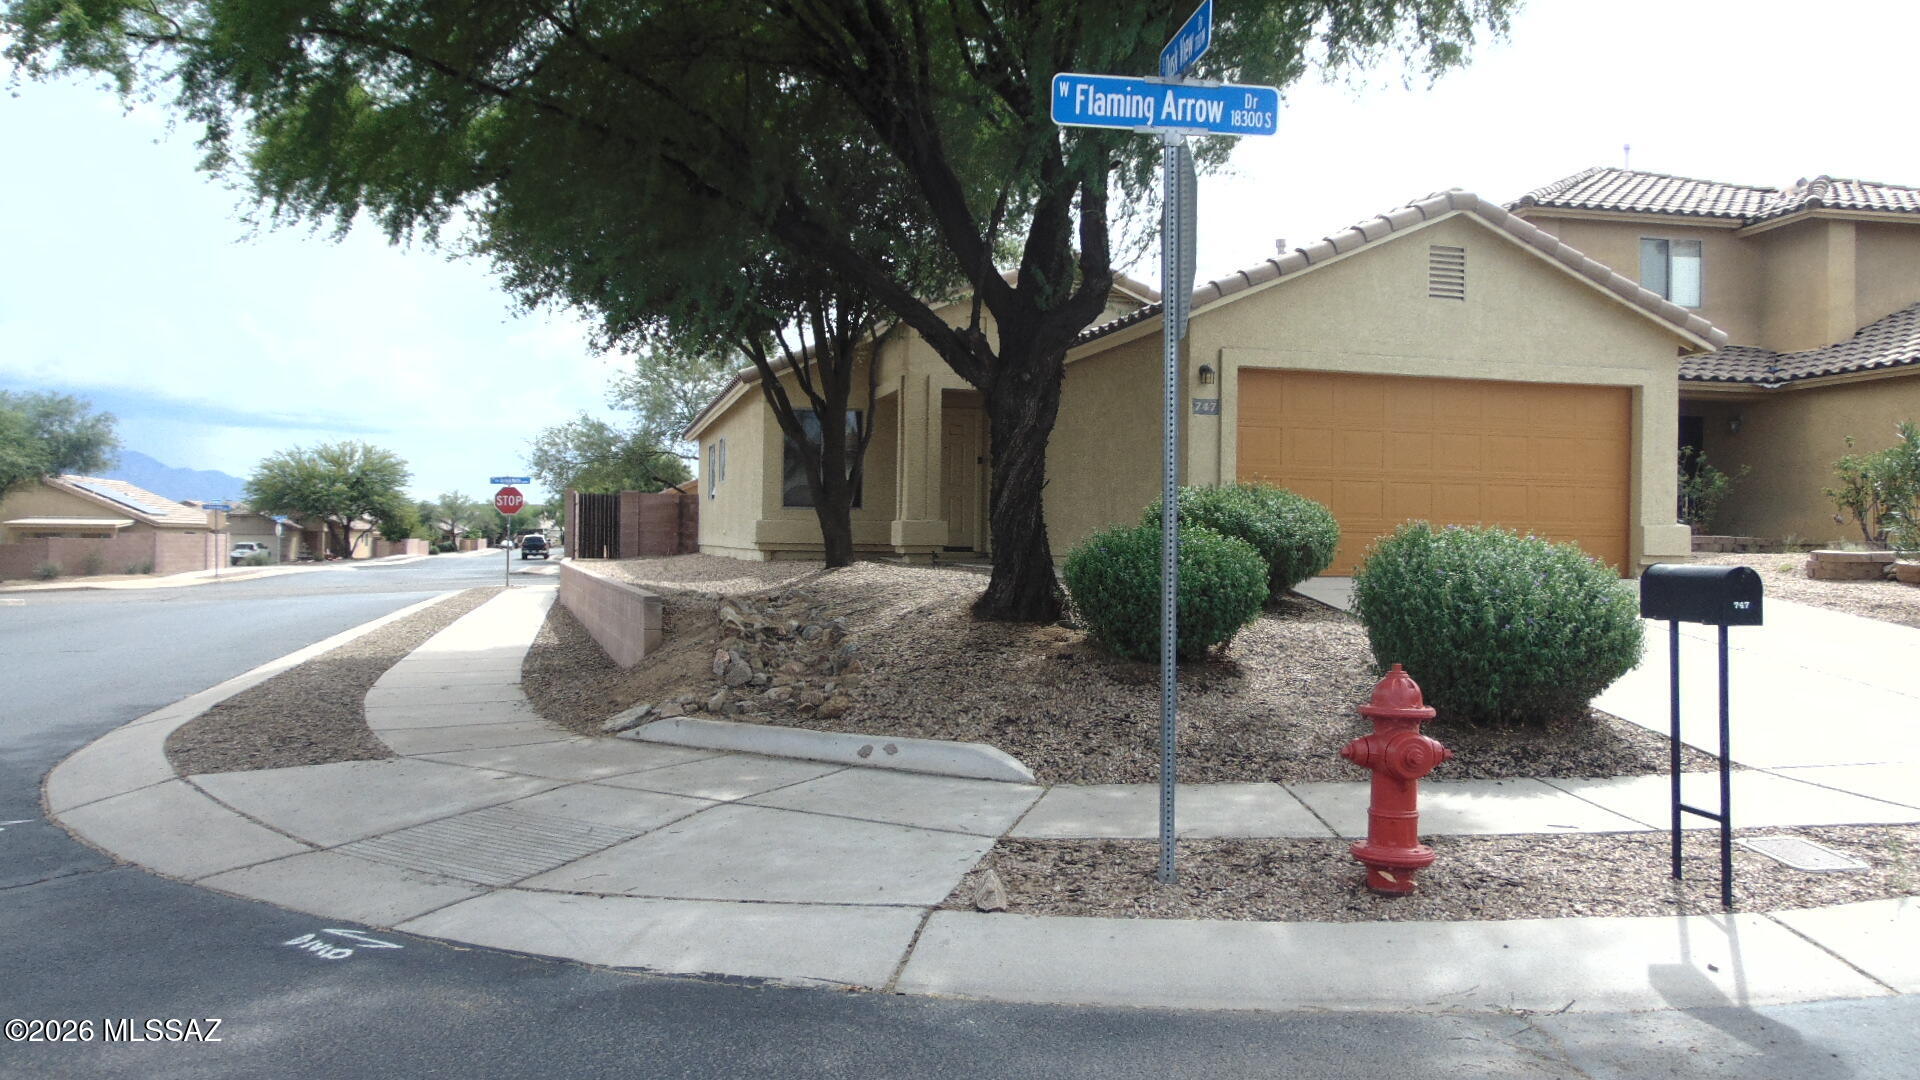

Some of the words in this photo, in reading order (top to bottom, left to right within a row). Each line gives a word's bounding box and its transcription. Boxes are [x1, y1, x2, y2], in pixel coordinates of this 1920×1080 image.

[1059, 82, 1069, 98] W
[1075, 83, 1154, 126] Flaming
[1160, 89, 1224, 123] Arrow
[1244, 93, 1258, 110] Dr
[1230, 109, 1264, 127] 18300
[1265, 112, 1272, 128] S
[496, 495, 522, 506] STOP
